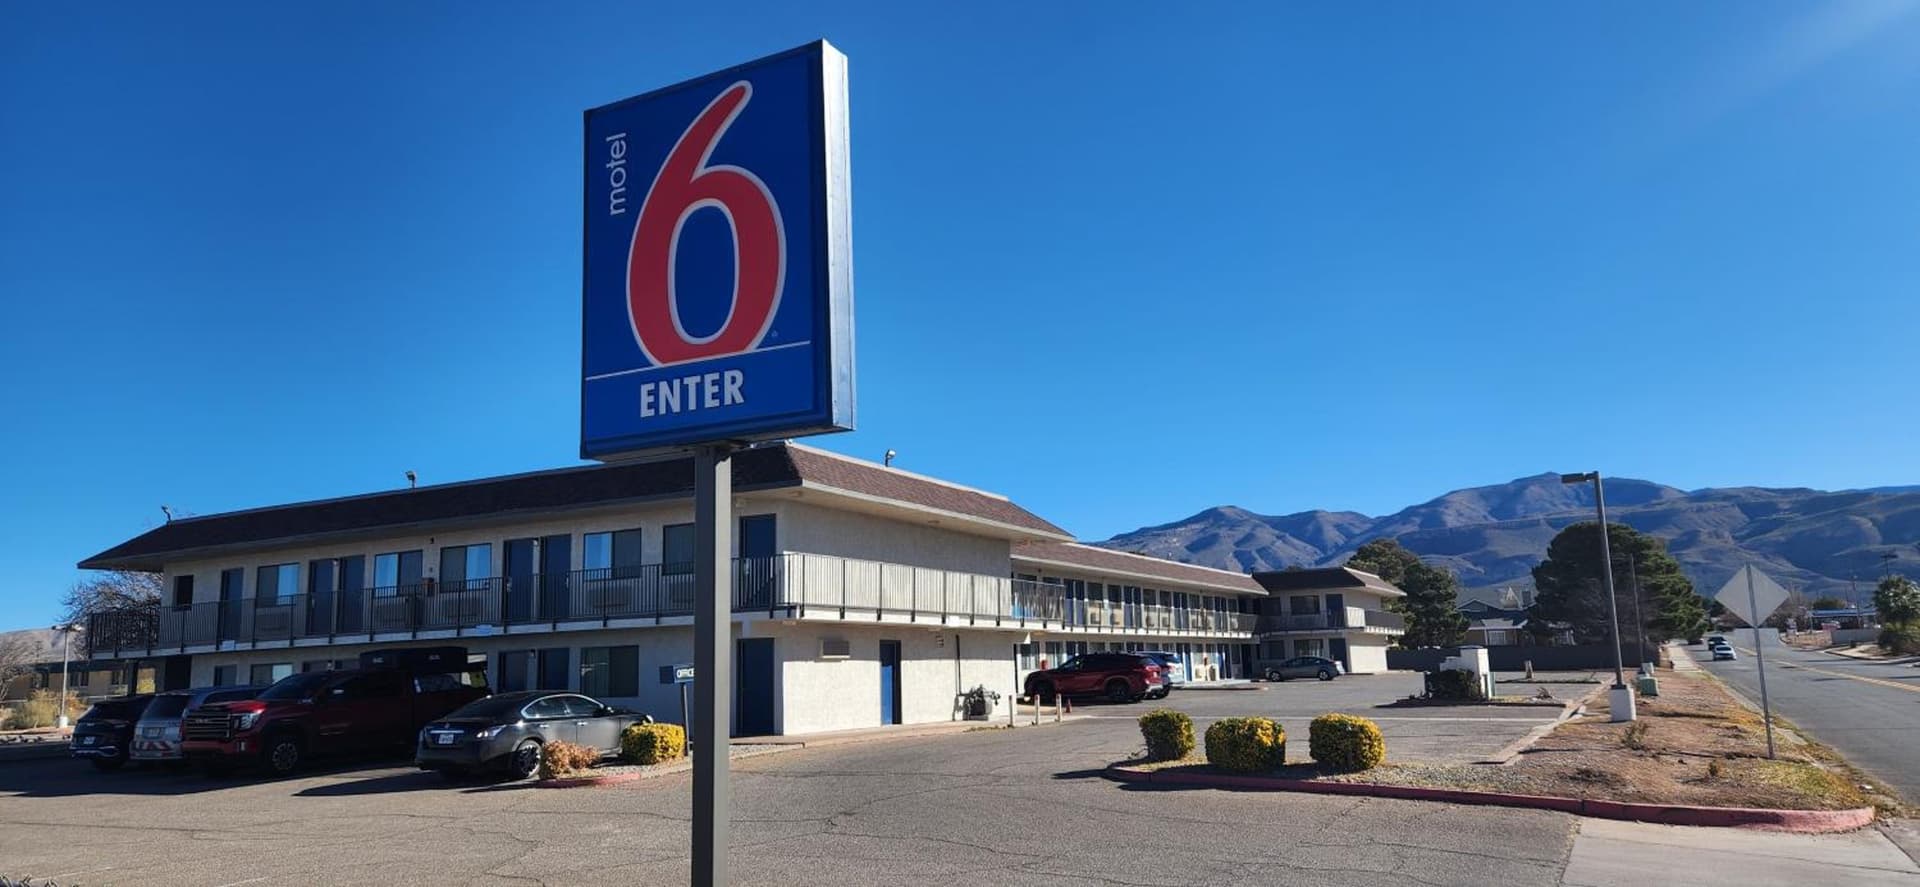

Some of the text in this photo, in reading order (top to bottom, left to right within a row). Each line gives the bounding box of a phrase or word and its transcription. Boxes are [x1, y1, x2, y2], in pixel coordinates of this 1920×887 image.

[606, 132, 627, 216] motel
[626, 79, 787, 367] 6
[640, 369, 745, 418] ENTER
